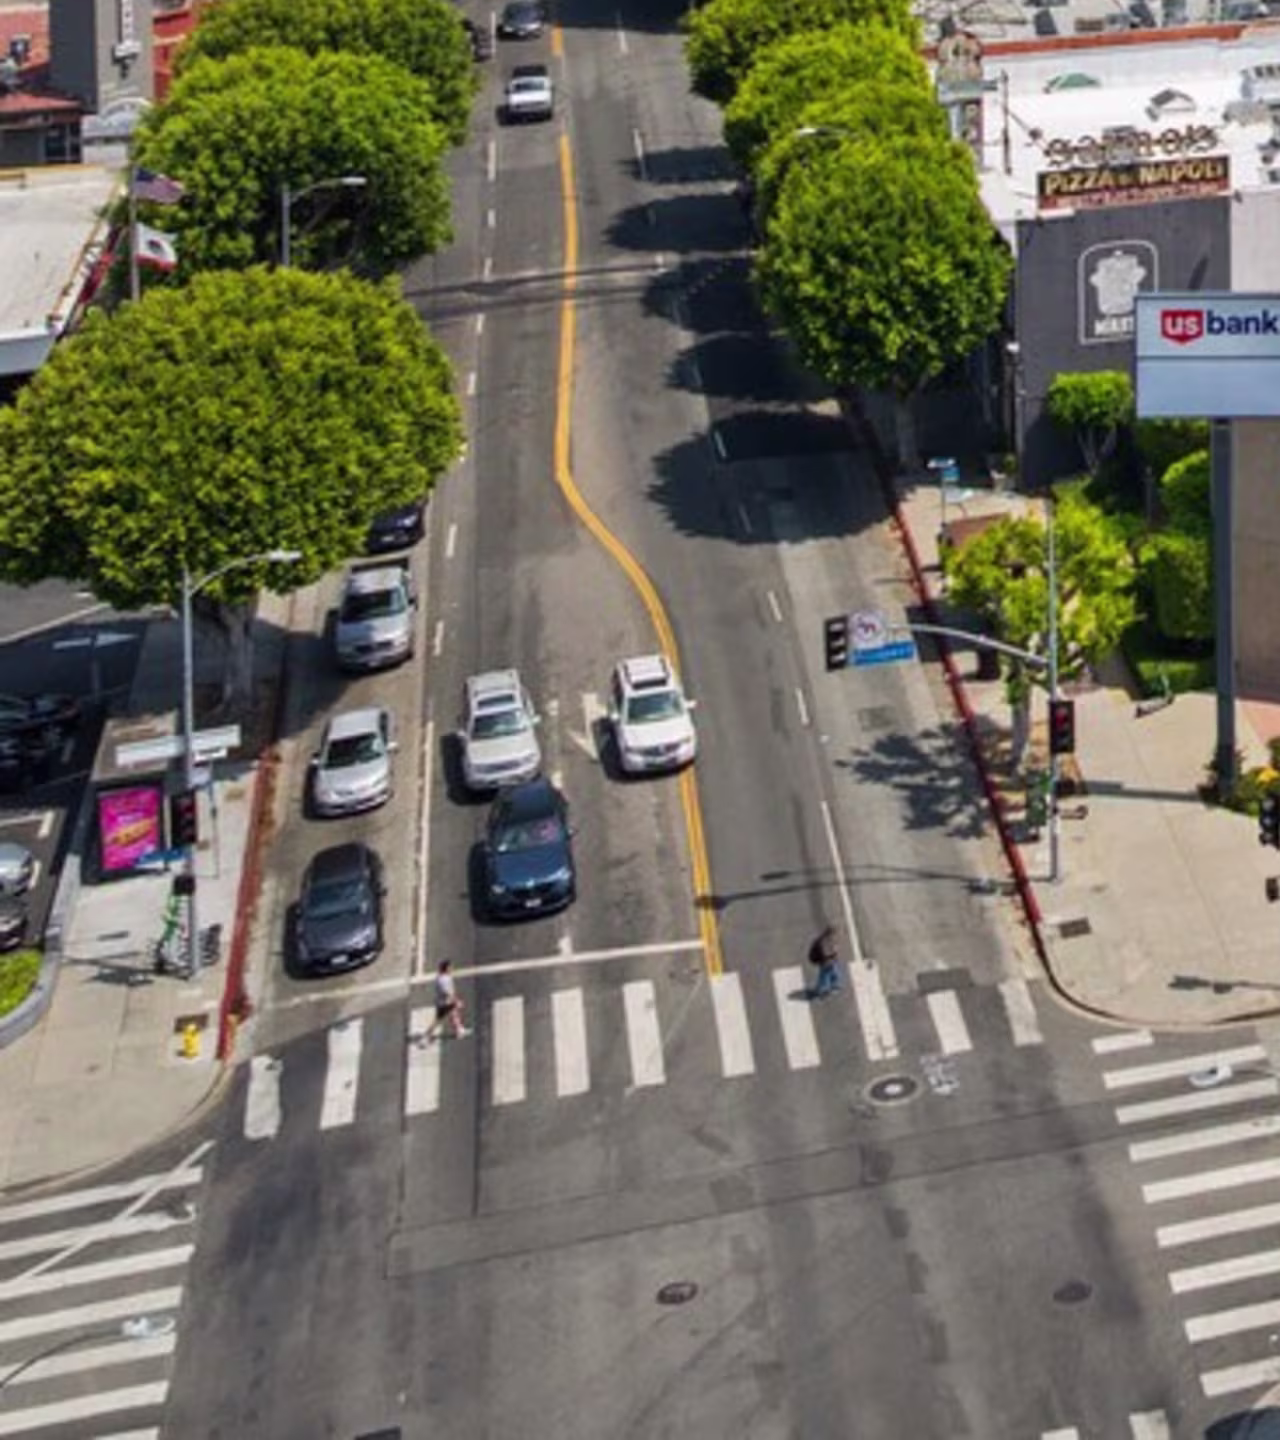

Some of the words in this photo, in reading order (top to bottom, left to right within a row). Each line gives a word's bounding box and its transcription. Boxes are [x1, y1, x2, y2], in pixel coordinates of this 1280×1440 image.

[1045, 168, 1116, 195] PIZZA
[1139, 160, 1223, 184] NAPOLI
[1206, 309, 1280, 335] bank
